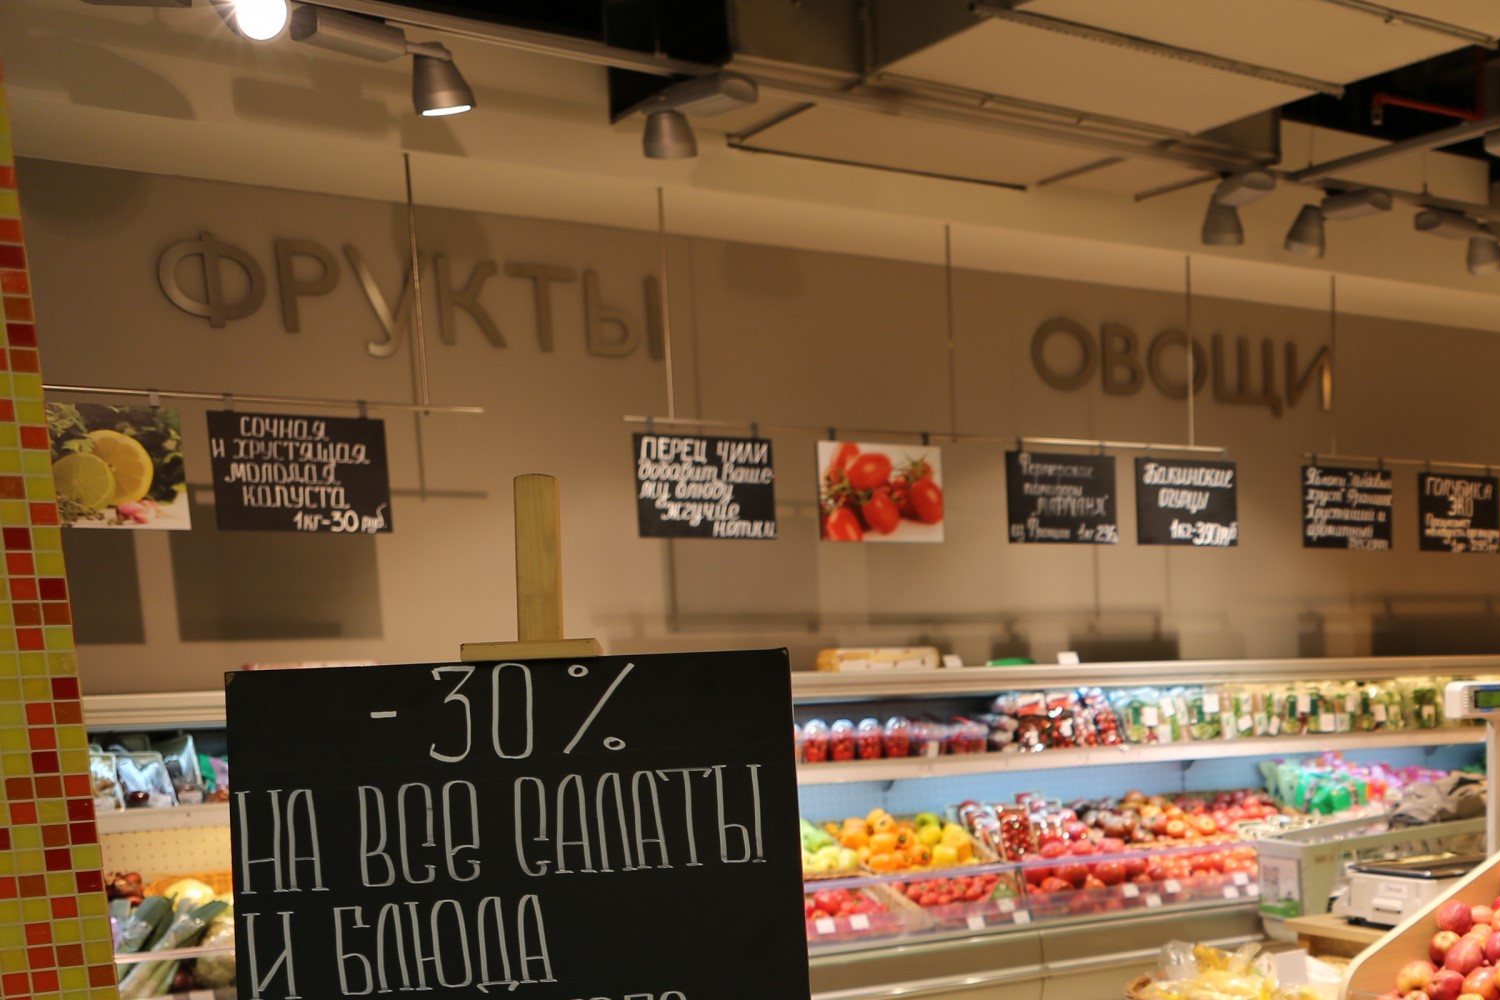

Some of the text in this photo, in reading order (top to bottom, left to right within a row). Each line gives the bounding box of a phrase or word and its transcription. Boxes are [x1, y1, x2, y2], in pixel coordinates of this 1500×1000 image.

[156, 230, 668, 362] ФРУКТЫ
[1030, 316, 1334, 417] ОВОЩИ
[640, 435, 769, 465] ПЕРЕЦ ЧИЛИ
[712, 519, 778, 539] нотки
[234, 763, 768, 895] НА ВСЕ САЛАТЫ
[332, 893, 559, 997] БЛЮДА
